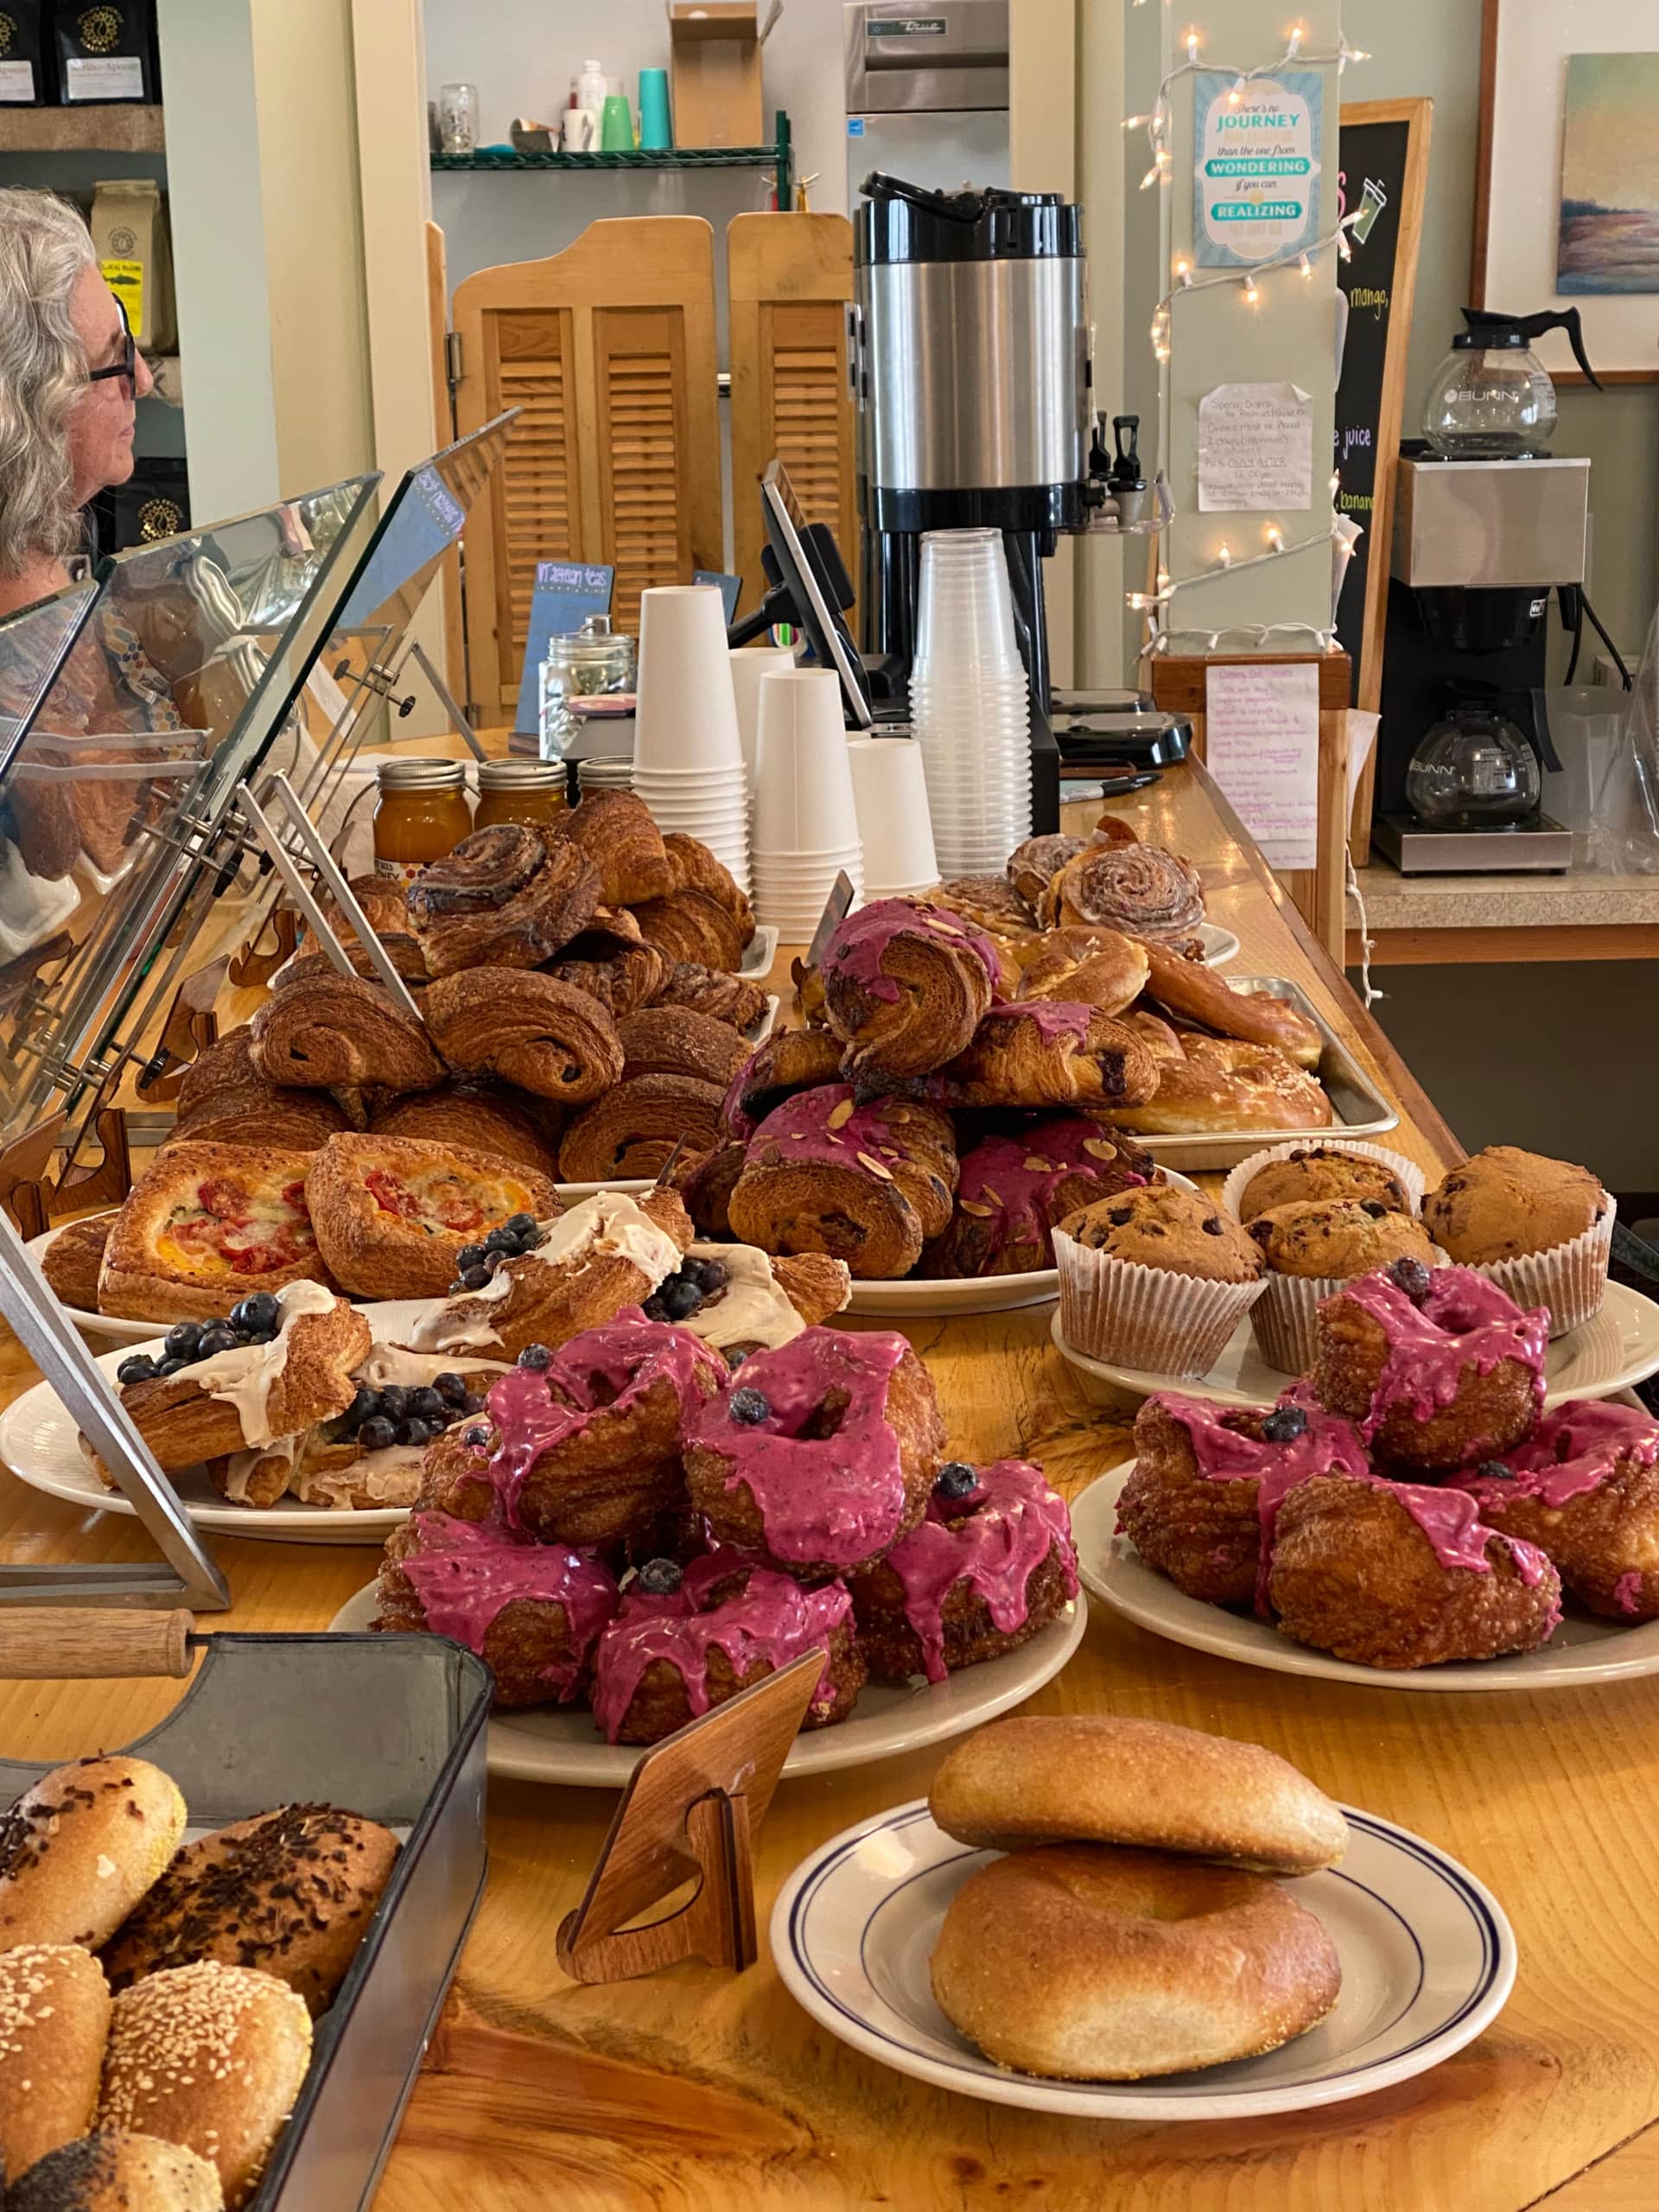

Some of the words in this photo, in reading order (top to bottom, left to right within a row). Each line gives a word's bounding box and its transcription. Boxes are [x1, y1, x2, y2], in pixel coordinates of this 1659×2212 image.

[1217, 113, 1300, 132] JOURNEY
[1217, 146, 1238, 156] than
[1240, 146, 1254, 156] the
[1271, 144, 1295, 157] from
[1211, 160, 1306, 174] WONDERING
[1244, 180, 1259, 191] you
[1261, 179, 1277, 188] can
[1217, 204, 1297, 218] REALIZING
[1350, 287, 1389, 321] mango,
[1459, 390, 1516, 402] BUNN
[1342, 424, 1371, 461] juice
[1340, 489, 1373, 511] banan
